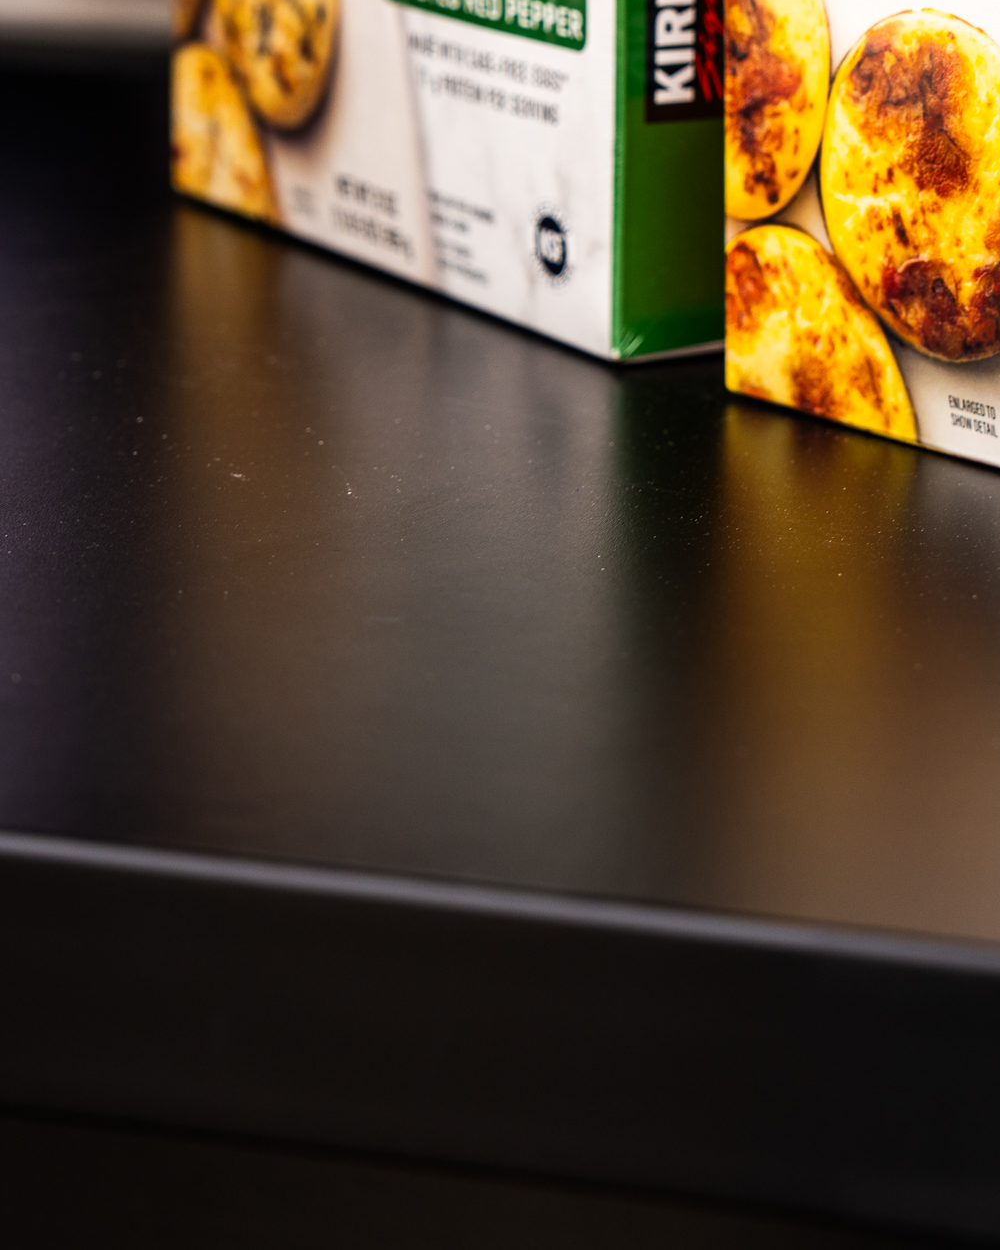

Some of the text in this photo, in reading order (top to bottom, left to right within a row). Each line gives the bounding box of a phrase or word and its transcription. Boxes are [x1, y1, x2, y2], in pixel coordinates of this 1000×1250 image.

[948, 395, 996, 420] ENLARGED TO
[951, 413, 998, 438] SHOW DETAIL
